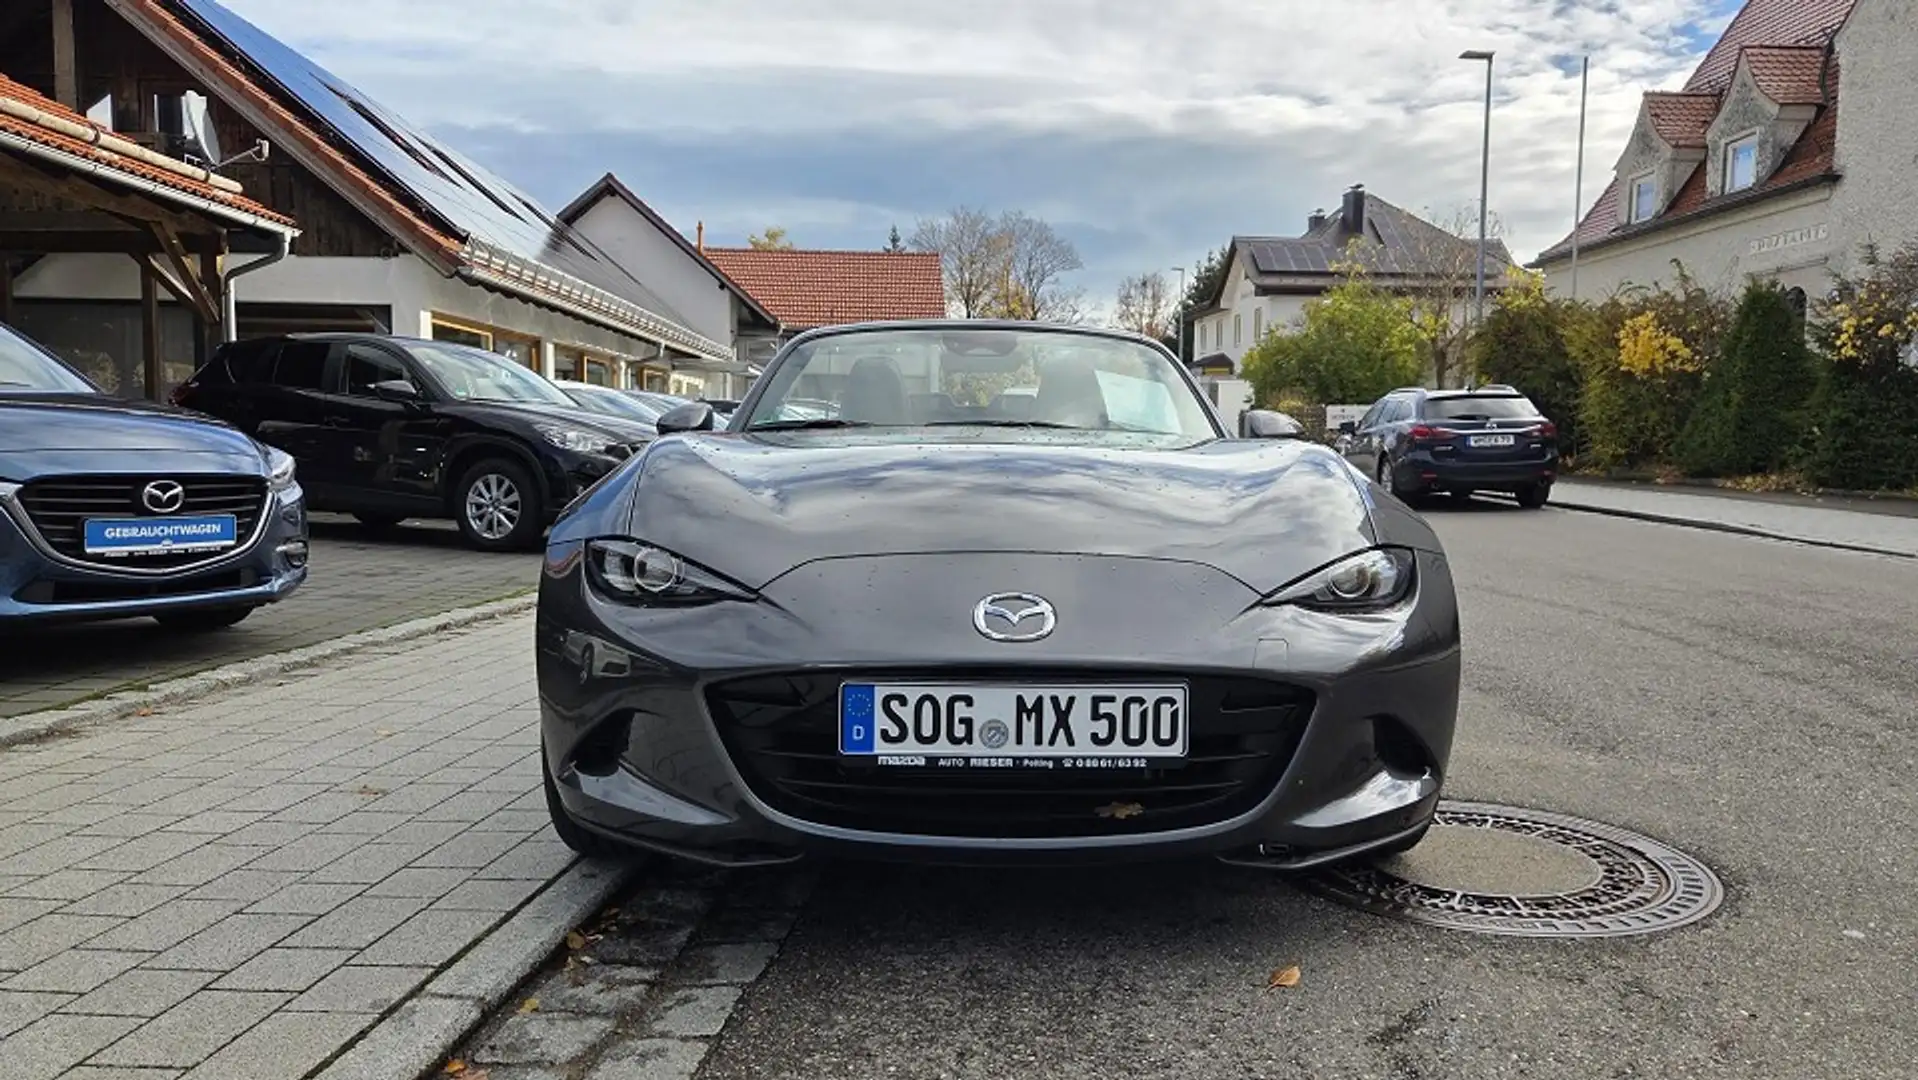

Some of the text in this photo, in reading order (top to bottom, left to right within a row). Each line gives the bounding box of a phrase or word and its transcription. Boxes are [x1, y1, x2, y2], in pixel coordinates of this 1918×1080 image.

[104, 523, 222, 539] GEBRAUCHTWAGEN
[879, 693, 974, 746] SOG
[1015, 694, 1076, 747] MX
[1089, 695, 1180, 747] 500
[852, 725, 865, 740] D
[877, 756, 926, 766] mazda
[938, 758, 965, 767] AUTO
[970, 758, 1014, 768] RIESER
